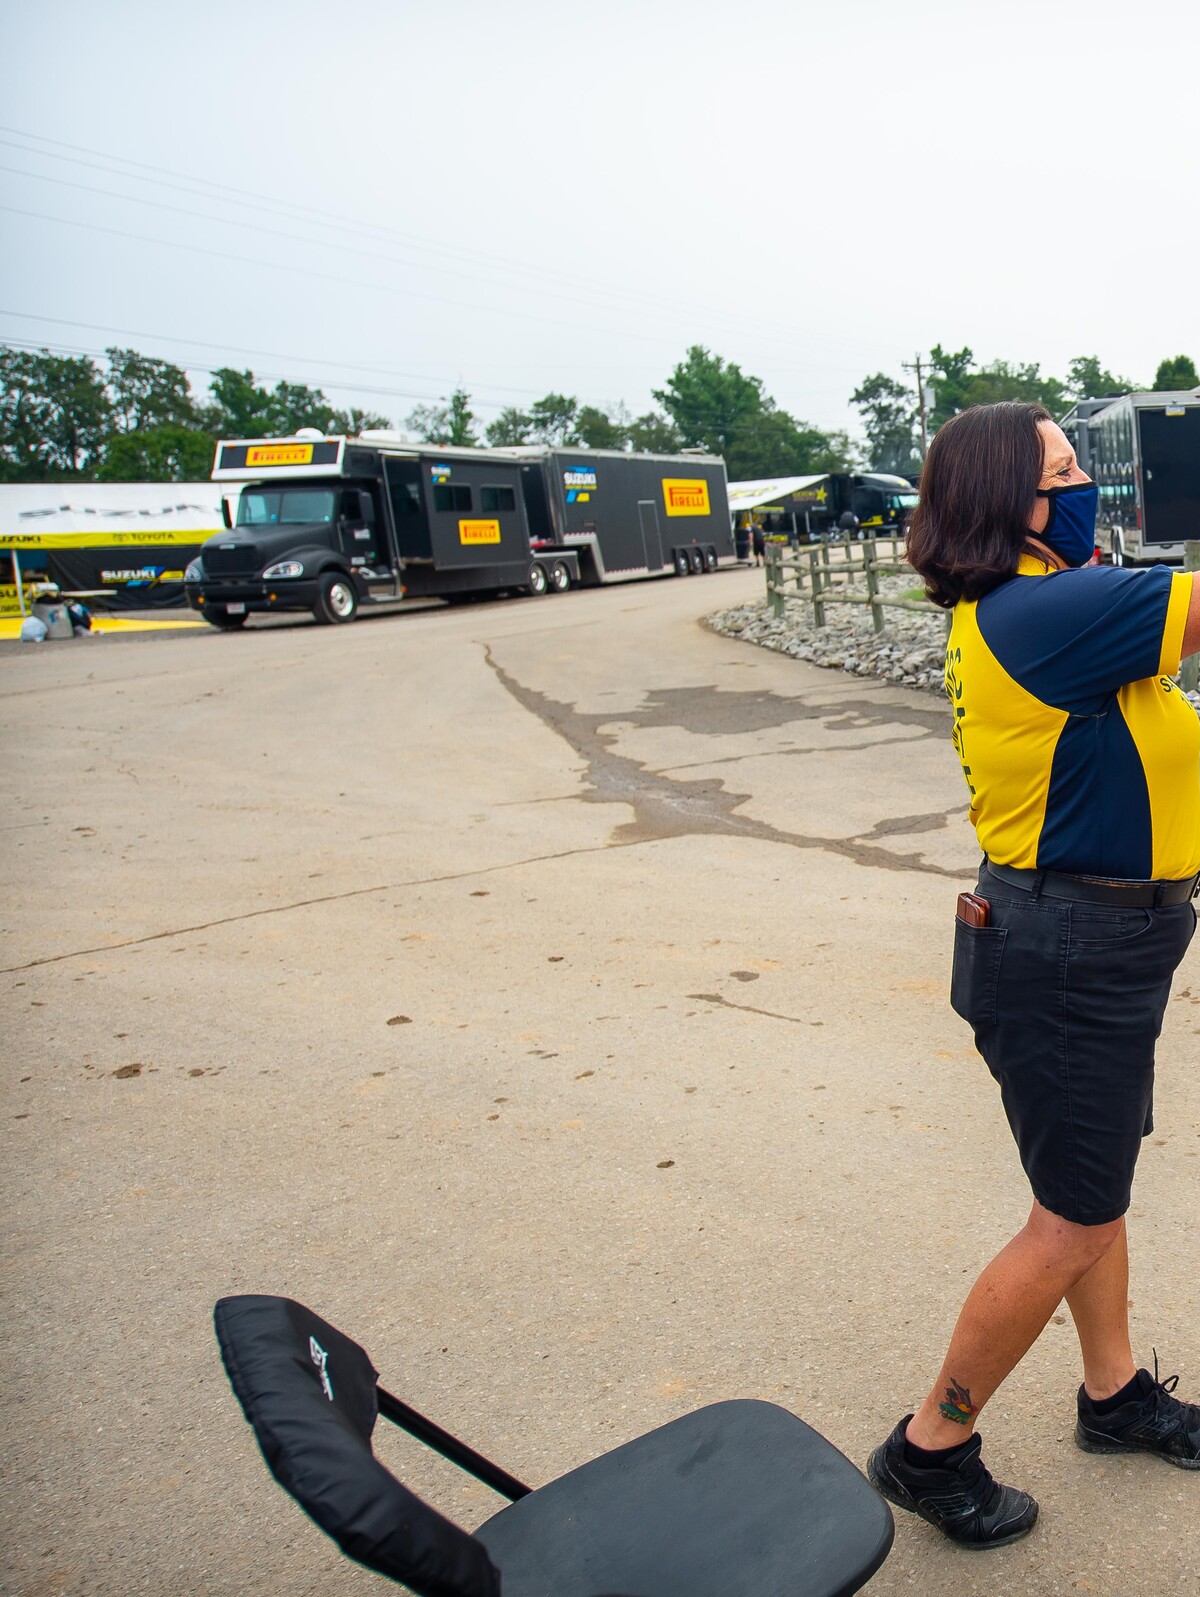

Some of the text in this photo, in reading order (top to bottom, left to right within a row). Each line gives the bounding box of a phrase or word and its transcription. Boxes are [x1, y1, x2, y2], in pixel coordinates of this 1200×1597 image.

[668, 486, 705, 507] PIRELLI
[463, 524, 496, 538] PIRELLI
[0, 535, 41, 544] UZUKI
[131, 533, 174, 541] TOYOTA
[101, 570, 156, 580] SUZUKI
